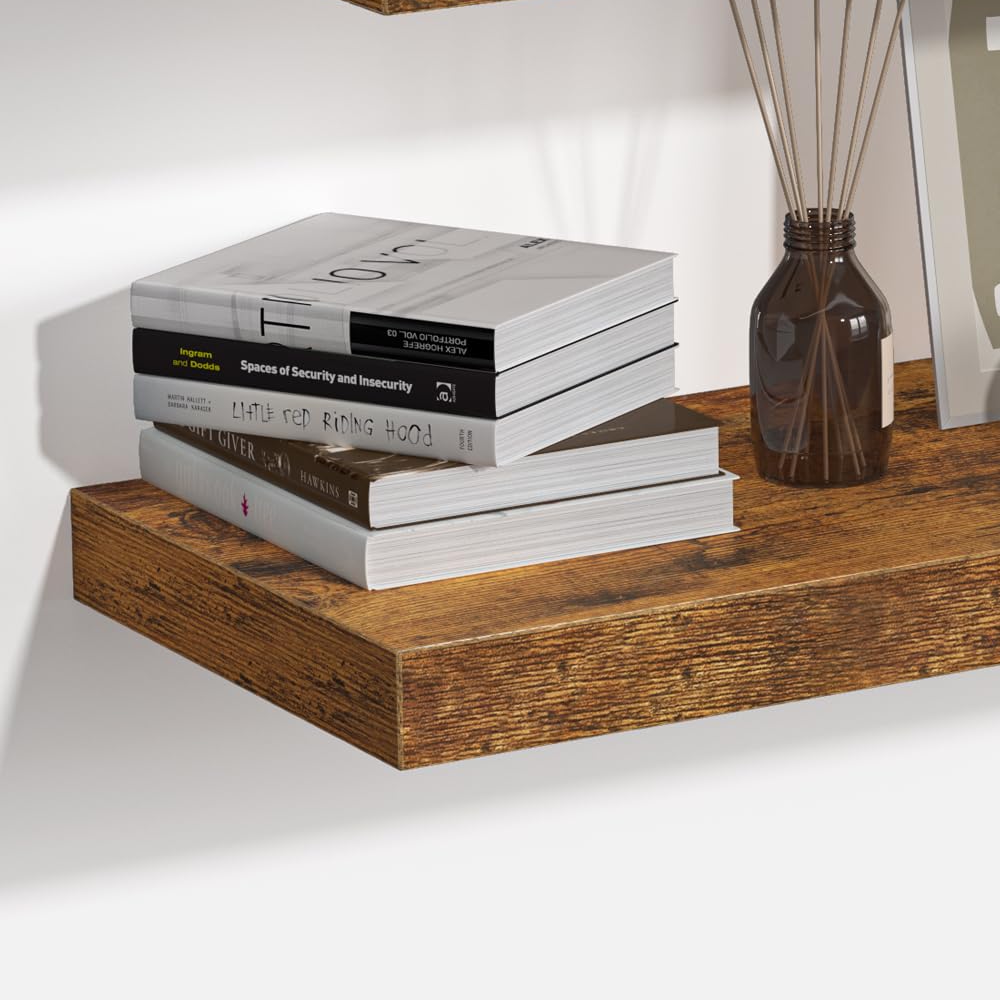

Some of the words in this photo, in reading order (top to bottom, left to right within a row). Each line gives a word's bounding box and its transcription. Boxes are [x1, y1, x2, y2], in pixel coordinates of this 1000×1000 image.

[386, 328, 398, 338] 03
[418, 333, 468, 346] PORTFOLIO
[402, 339, 444, 352] HOGREFE
[445, 343, 468, 355] ALEX
[180, 347, 212, 359] Ingram
[172, 359, 188, 367] and
[190, 360, 221, 371] Dodds
[240, 359, 278, 374] Spaces
[279, 365, 290, 376] of
[291, 366, 336, 384] Security
[337, 374, 357, 385] and
[359, 374, 413, 394] Insecurity
[218, 431, 256, 461] GIVER
[300, 470, 341, 498] HAWKINS
